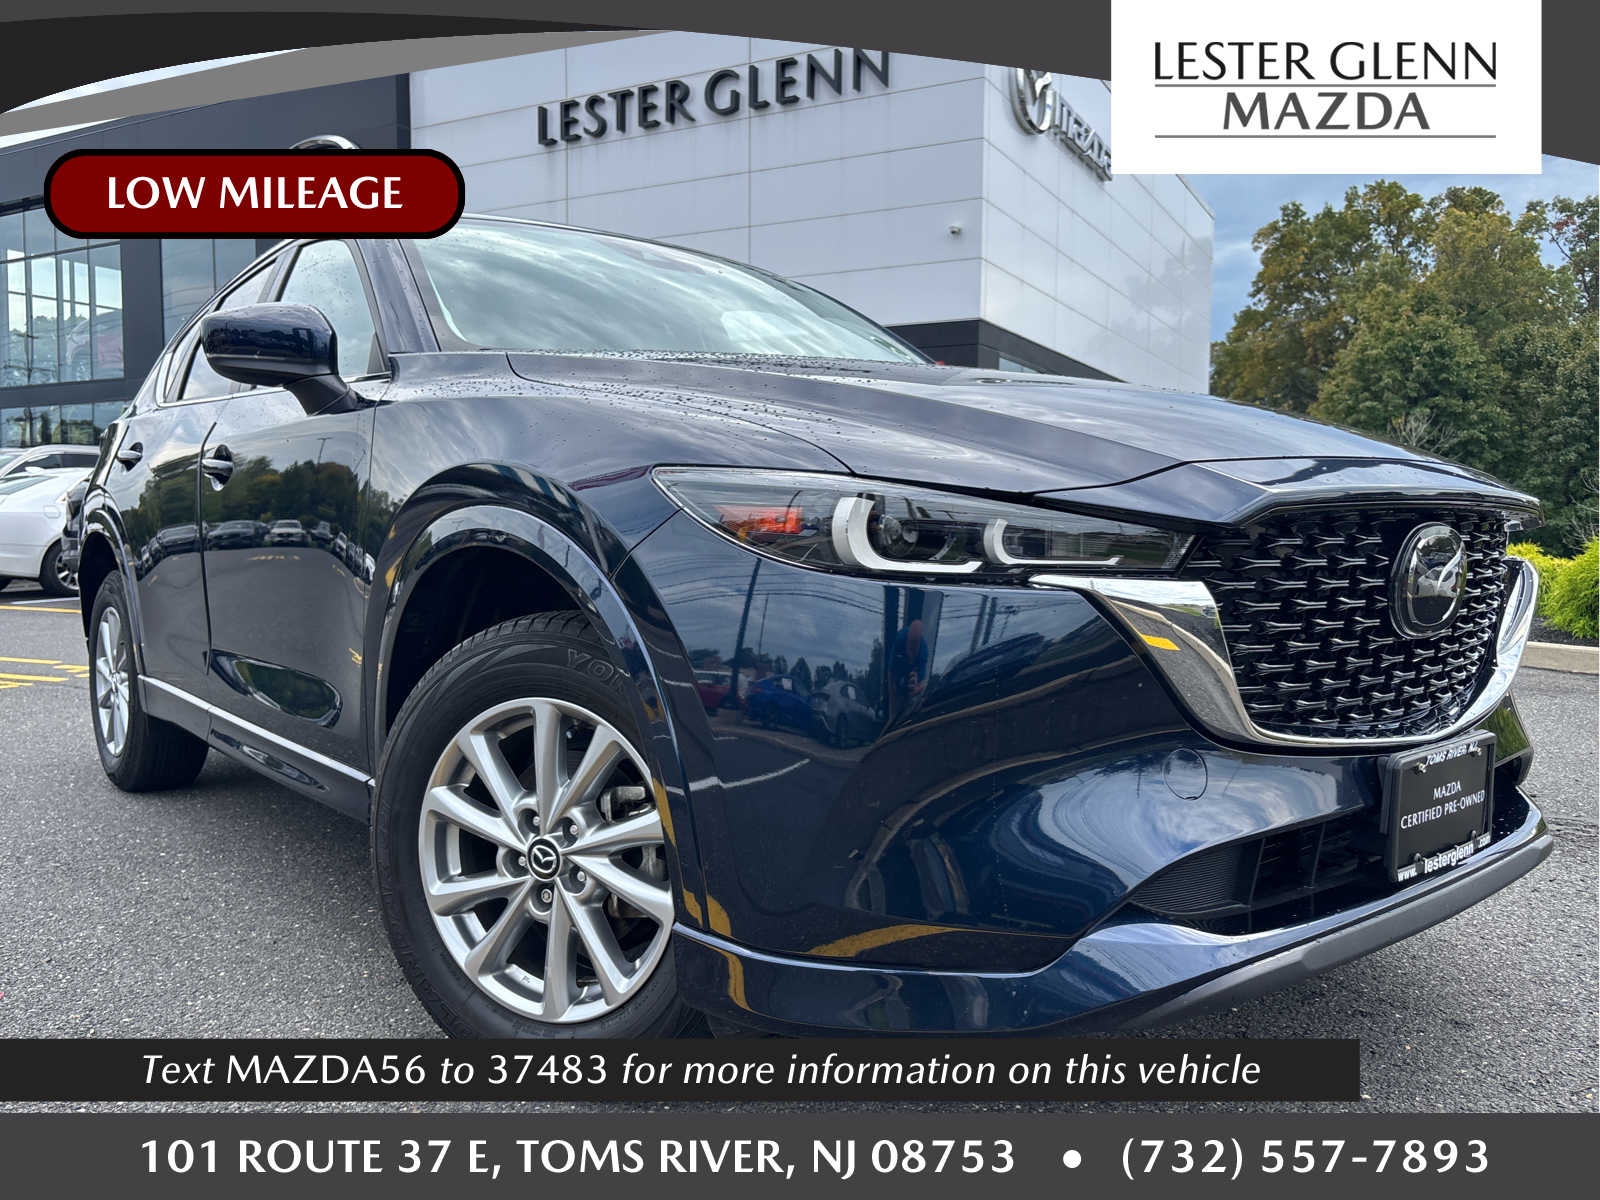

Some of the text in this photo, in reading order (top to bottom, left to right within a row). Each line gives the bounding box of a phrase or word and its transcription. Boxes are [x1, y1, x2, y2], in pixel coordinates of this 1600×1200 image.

[537, 48, 890, 146] LESTER GLENN
[1433, 780, 1462, 800] MAZDA
[1400, 789, 1485, 829] CERTIFIED PRE-OWNED
[1422, 843, 1474, 874] lesterglenn
